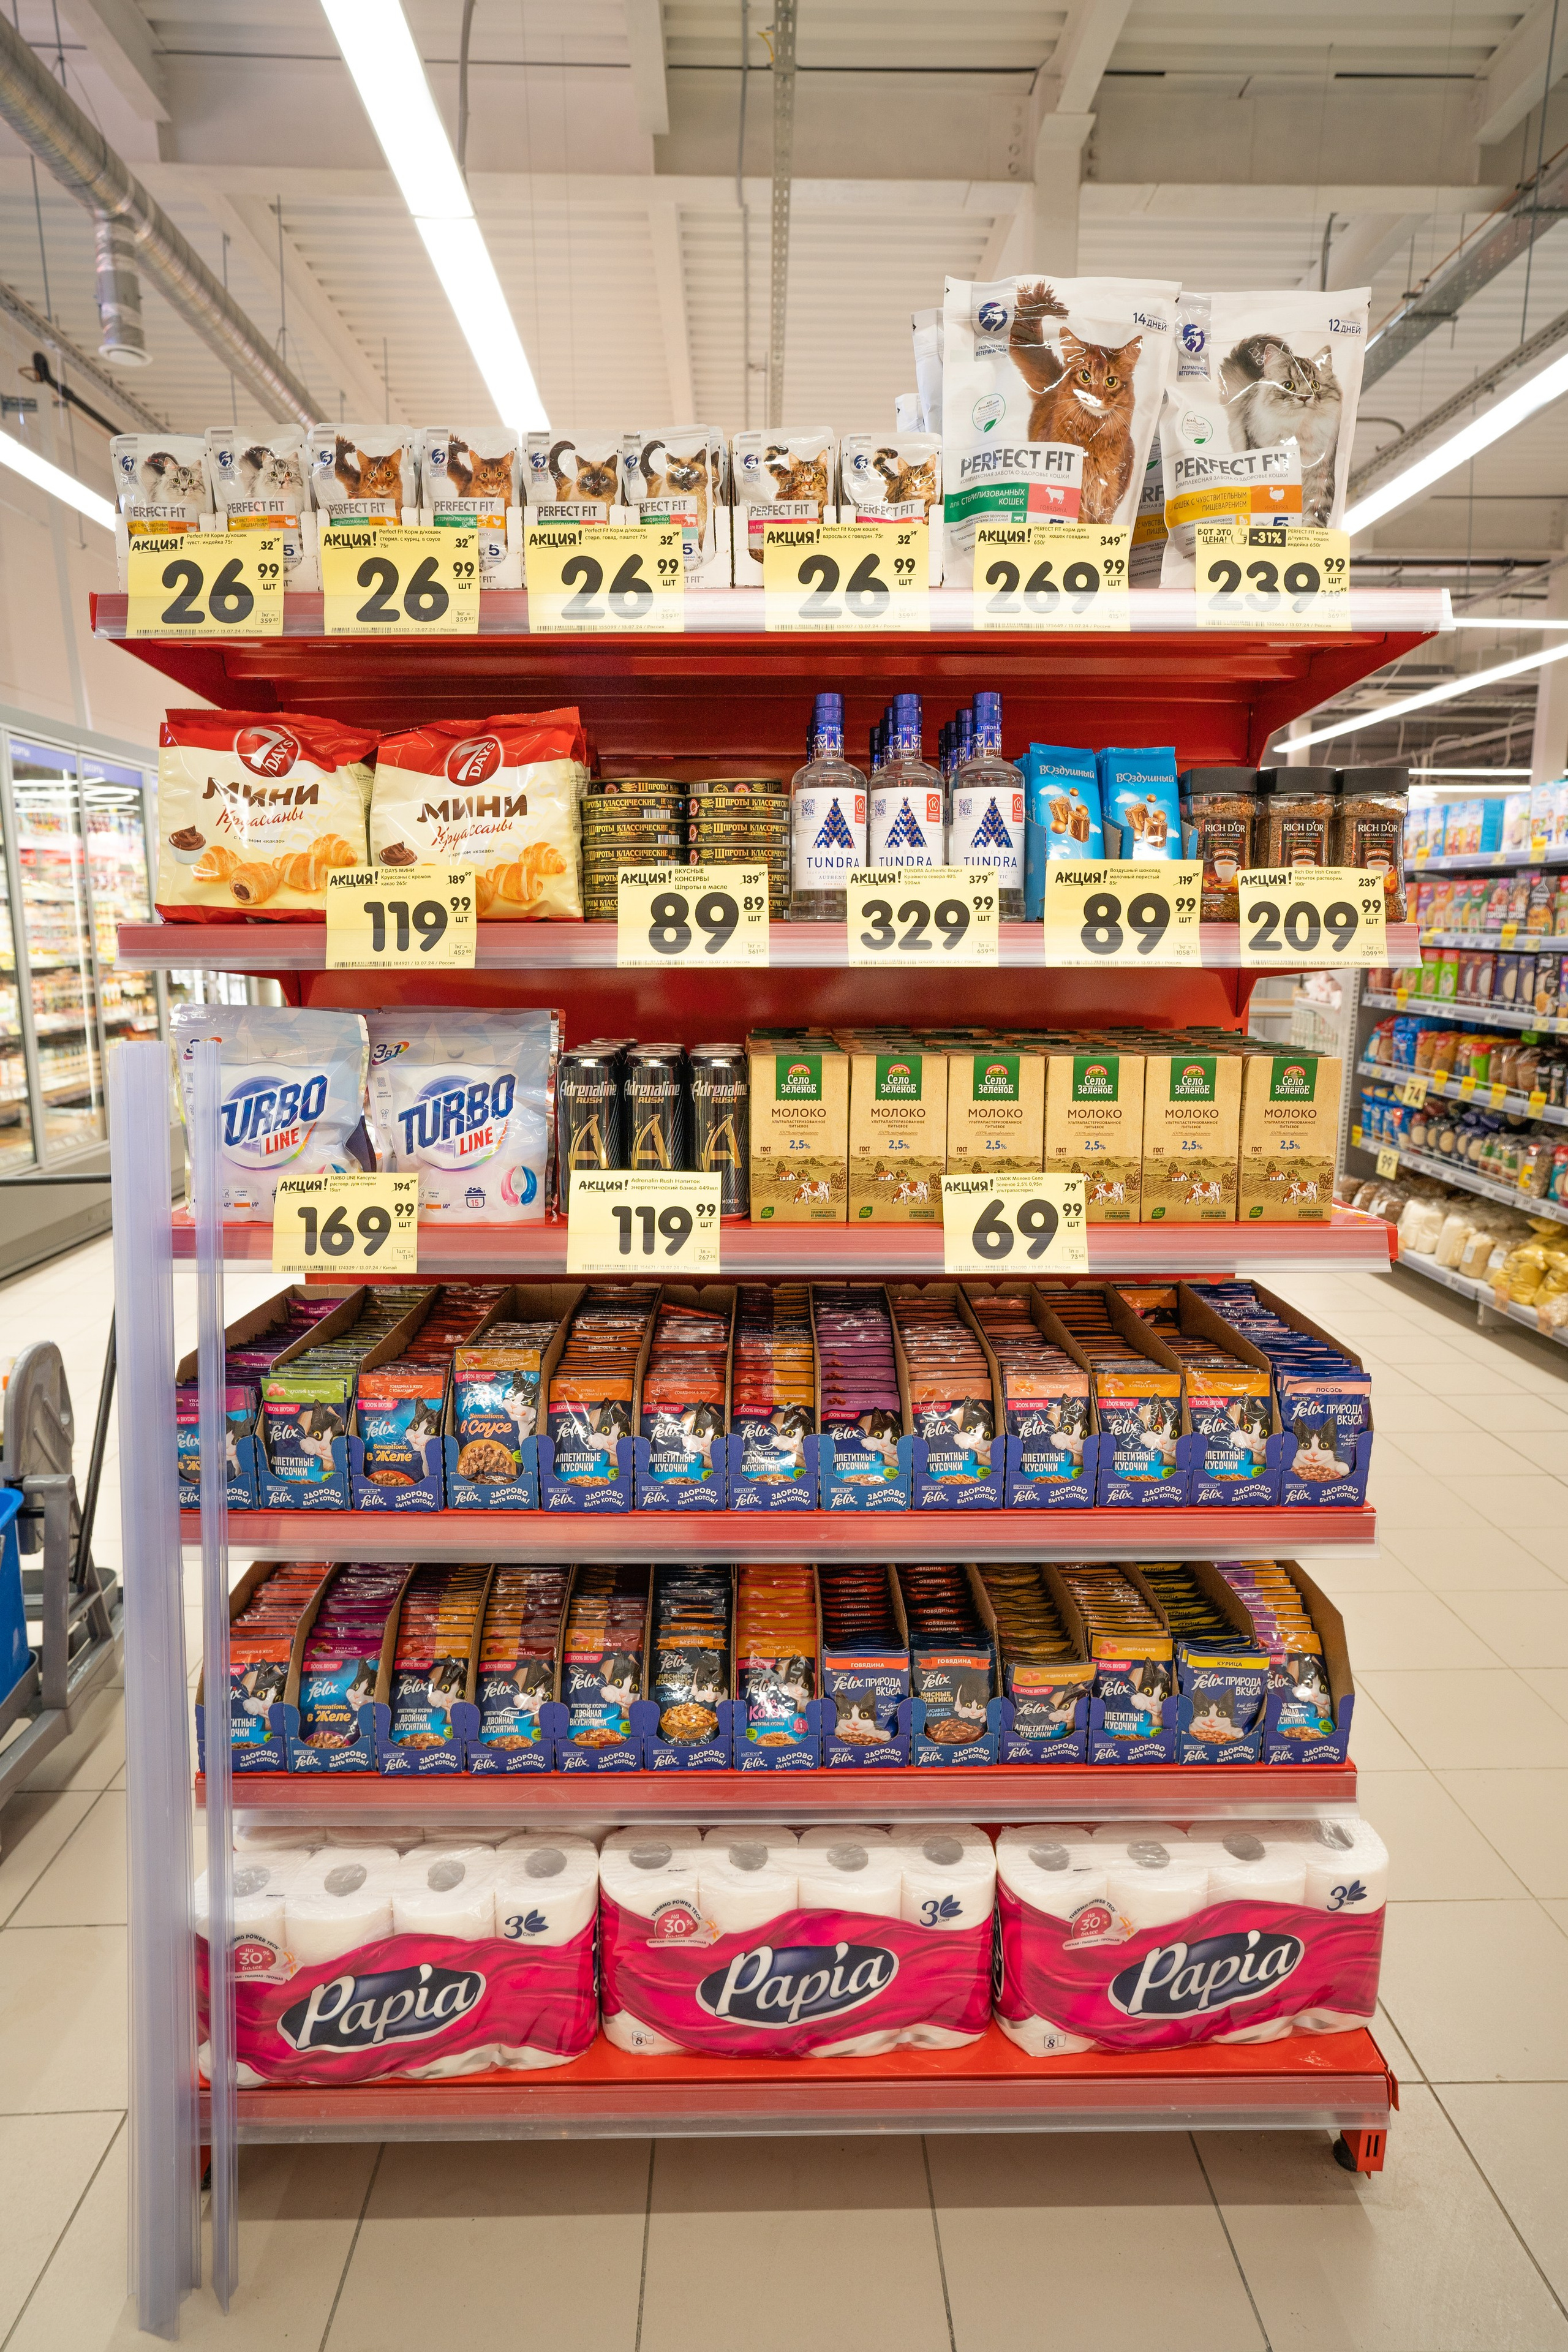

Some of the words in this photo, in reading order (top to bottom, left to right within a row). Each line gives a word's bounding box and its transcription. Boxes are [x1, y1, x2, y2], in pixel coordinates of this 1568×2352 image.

[961, 449, 1041, 478] PERFECT
[1046, 451, 1075, 472] FIT
[960, 472, 993, 484] КОМПЛЕКСНАЯ
[962, 489, 1025, 505] СТЕРИЛИЗОВАННЫХ
[1196, 492, 1247, 503] ЧУВСТВИТЕЛЬНЫМ
[538, 506, 579, 516] PERFECT
[582, 506, 597, 516] FIT
[1202, 501, 1247, 511] ПИЩЕВАРЕНИЕМ
[132, 537, 184, 552] АКЦИЯ!
[978, 529, 1031, 545] АКЦИЯ!
[1252, 531, 1282, 545] -31%
[162, 558, 254, 624] 26
[258, 564, 279, 578] 99
[356, 557, 449, 622] 26
[453, 562, 475, 577] 99
[561, 554, 654, 620] 26
[657, 559, 679, 573] 99
[798, 553, 890, 619] 26
[894, 558, 916, 573] 99
[986, 561, 1100, 614] 269
[1103, 559, 1125, 574] 99
[1207, 560, 1321, 613] 239
[1324, 557, 1346, 573] 99
[469, 742, 496, 777] DAYS
[417, 794, 527, 823] МИНИ
[1283, 823, 1304, 832] RICH
[431, 819, 513, 853] Круассаны
[807, 857, 859, 869] TUNDRA
[330, 871, 379, 888] АКЦИЯ!
[621, 870, 673, 886] АКЦИЯ!
[850, 871, 901, 886] АКЦИЯ!
[1055, 870, 1107, 884] АКЦИЯ!
[1240, 872, 1292, 886] АКЦИЯ!
[364, 900, 448, 952] 119
[450, 897, 471, 911] 99
[649, 892, 739, 955] 89
[744, 896, 764, 910] 89
[861, 899, 970, 951] 329
[973, 896, 993, 910] 99
[1080, 893, 1170, 955] 89
[1175, 898, 1196, 911] 99
[1248, 901, 1359, 952] 209
[1362, 899, 1381, 913] 99
[787, 1074, 809, 1085] Село
[560, 1080, 617, 1102] Adrenaline
[398, 1074, 516, 1155] TURBO
[771, 1108, 826, 1117] МОЛОКО
[968, 1109, 1023, 1118] МОЛОКО
[460, 1126, 493, 1155] LINE
[790, 1140, 810, 1150] 2,5%
[280, 1178, 328, 1193] АКЦИЯ!
[579, 1180, 628, 1193] АКЦИЯ!
[945, 1179, 993, 1194] АКЦИЯ!
[298, 1206, 391, 1256] 169
[394, 1204, 414, 1216] 99
[612, 1206, 693, 1256] 119
[696, 1204, 716, 1216] 99
[972, 1199, 1058, 1260] 69
[1063, 1204, 1082, 1216] 99
[1326, 1404, 1363, 1414] ПРИРОДА
[1337, 1415, 1362, 1425] ВКУСА
[469, 1420, 512, 1438] Соусе
[271, 1457, 314, 1468] АППЕТИТНЫЕ
[276, 1466, 307, 1476] КУСОЧКИ
[304, 1489, 341, 1501] ЗДОРОВО
[319, 1496, 343, 1506] КОТОМ!
[651, 1901, 671, 1917] THERMO
[673, 1899, 692, 1908] POWER
[1127, 1929, 1294, 2015] Papia
[715, 1942, 891, 2024] Papia
[295, 1963, 478, 2051] Papia
